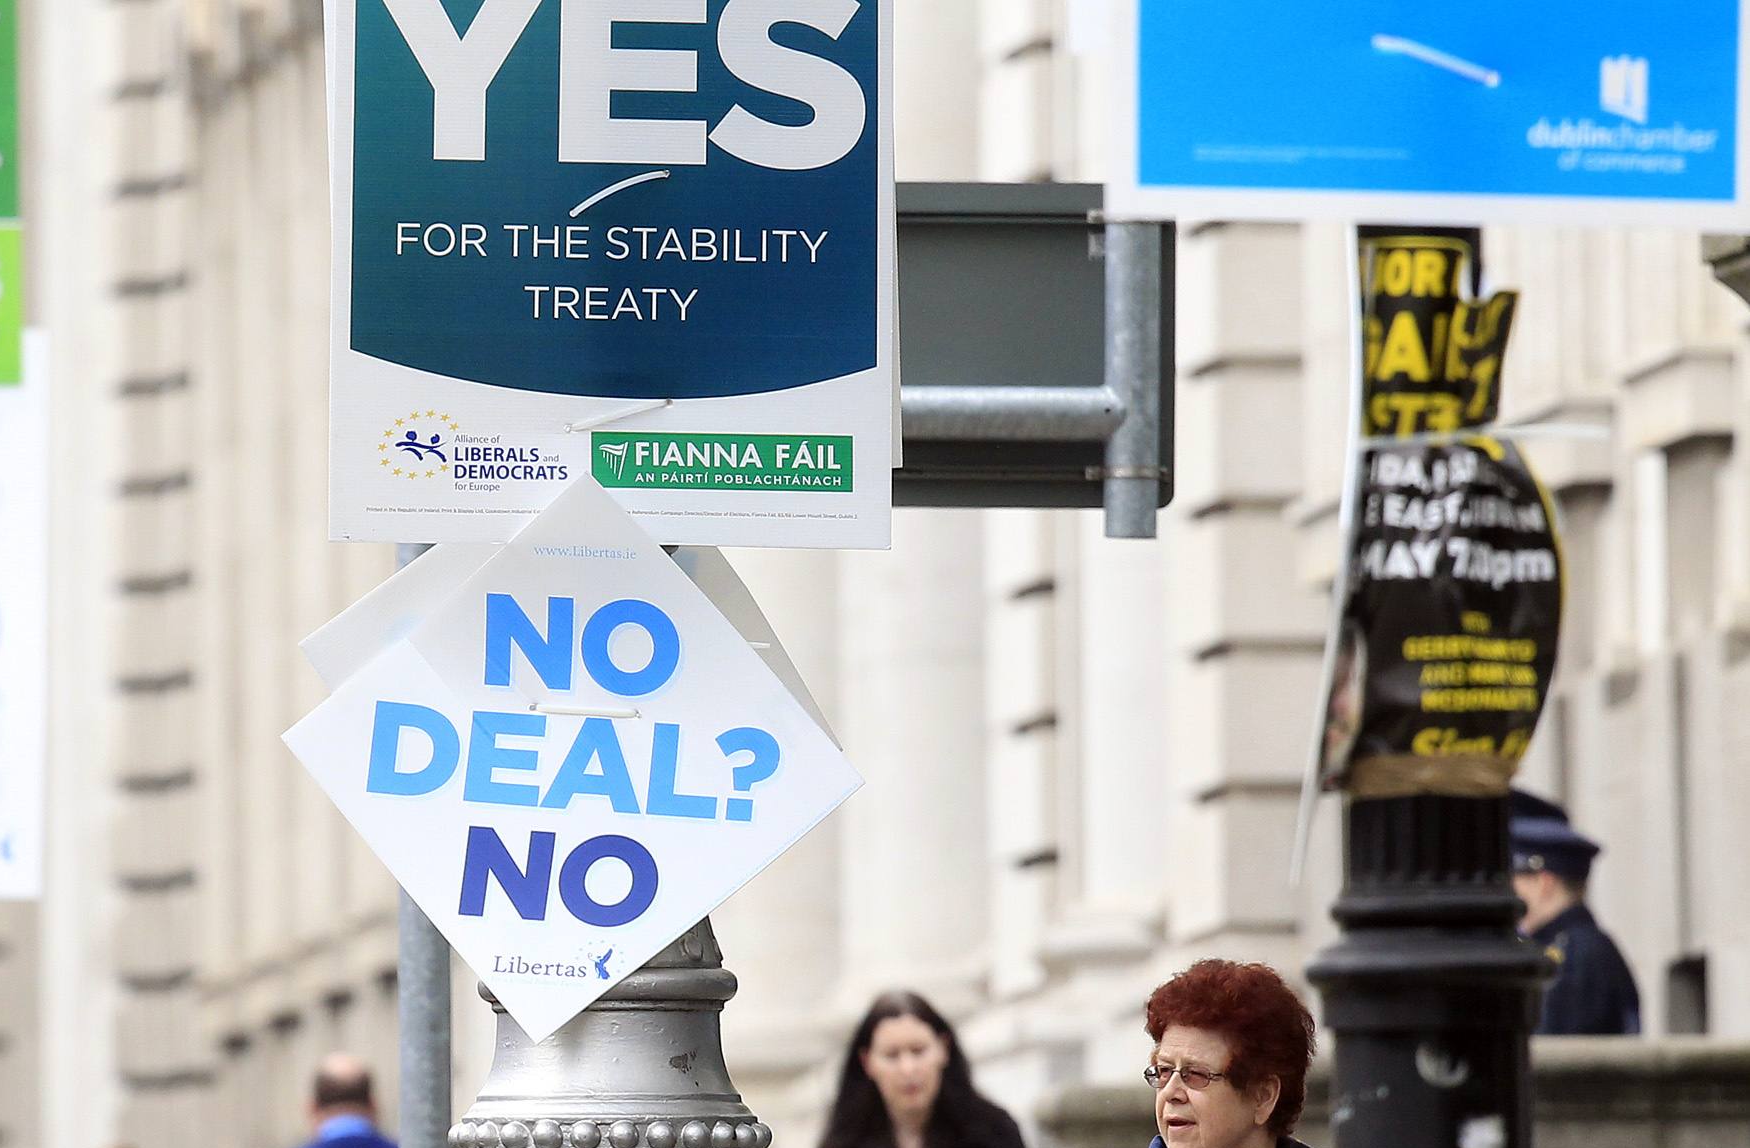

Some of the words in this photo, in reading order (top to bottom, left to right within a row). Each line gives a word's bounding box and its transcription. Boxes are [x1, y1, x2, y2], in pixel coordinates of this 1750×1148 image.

[380, 0, 866, 171] YES
[396, 222, 488, 258] FOR
[503, 224, 590, 260] THE
[605, 226, 829, 264] STABILITY
[524, 285, 699, 321] TREATY
[454, 434, 489, 443] Alliance
[490, 434, 500, 443] of
[454, 446, 540, 462] LIBERALS
[542, 454, 559, 462] and
[634, 441, 763, 468] FIANNA
[776, 440, 842, 470] FÁIL
[454, 464, 568, 480] DEMOCRATS
[635, 472, 655, 483] AN
[661, 471, 709, 483] PÁIRTÍ
[714, 473, 842, 486] POBLACHTÁNACH
[454, 482, 467, 491] for
[469, 482, 500, 492] Europe
[534, 546, 637, 560] www.Libertas.ie
[484, 592, 681, 697] NO
[366, 700, 782, 822] DEAL?
[458, 825, 660, 928] NO
[493, 954, 588, 978] Libertas
